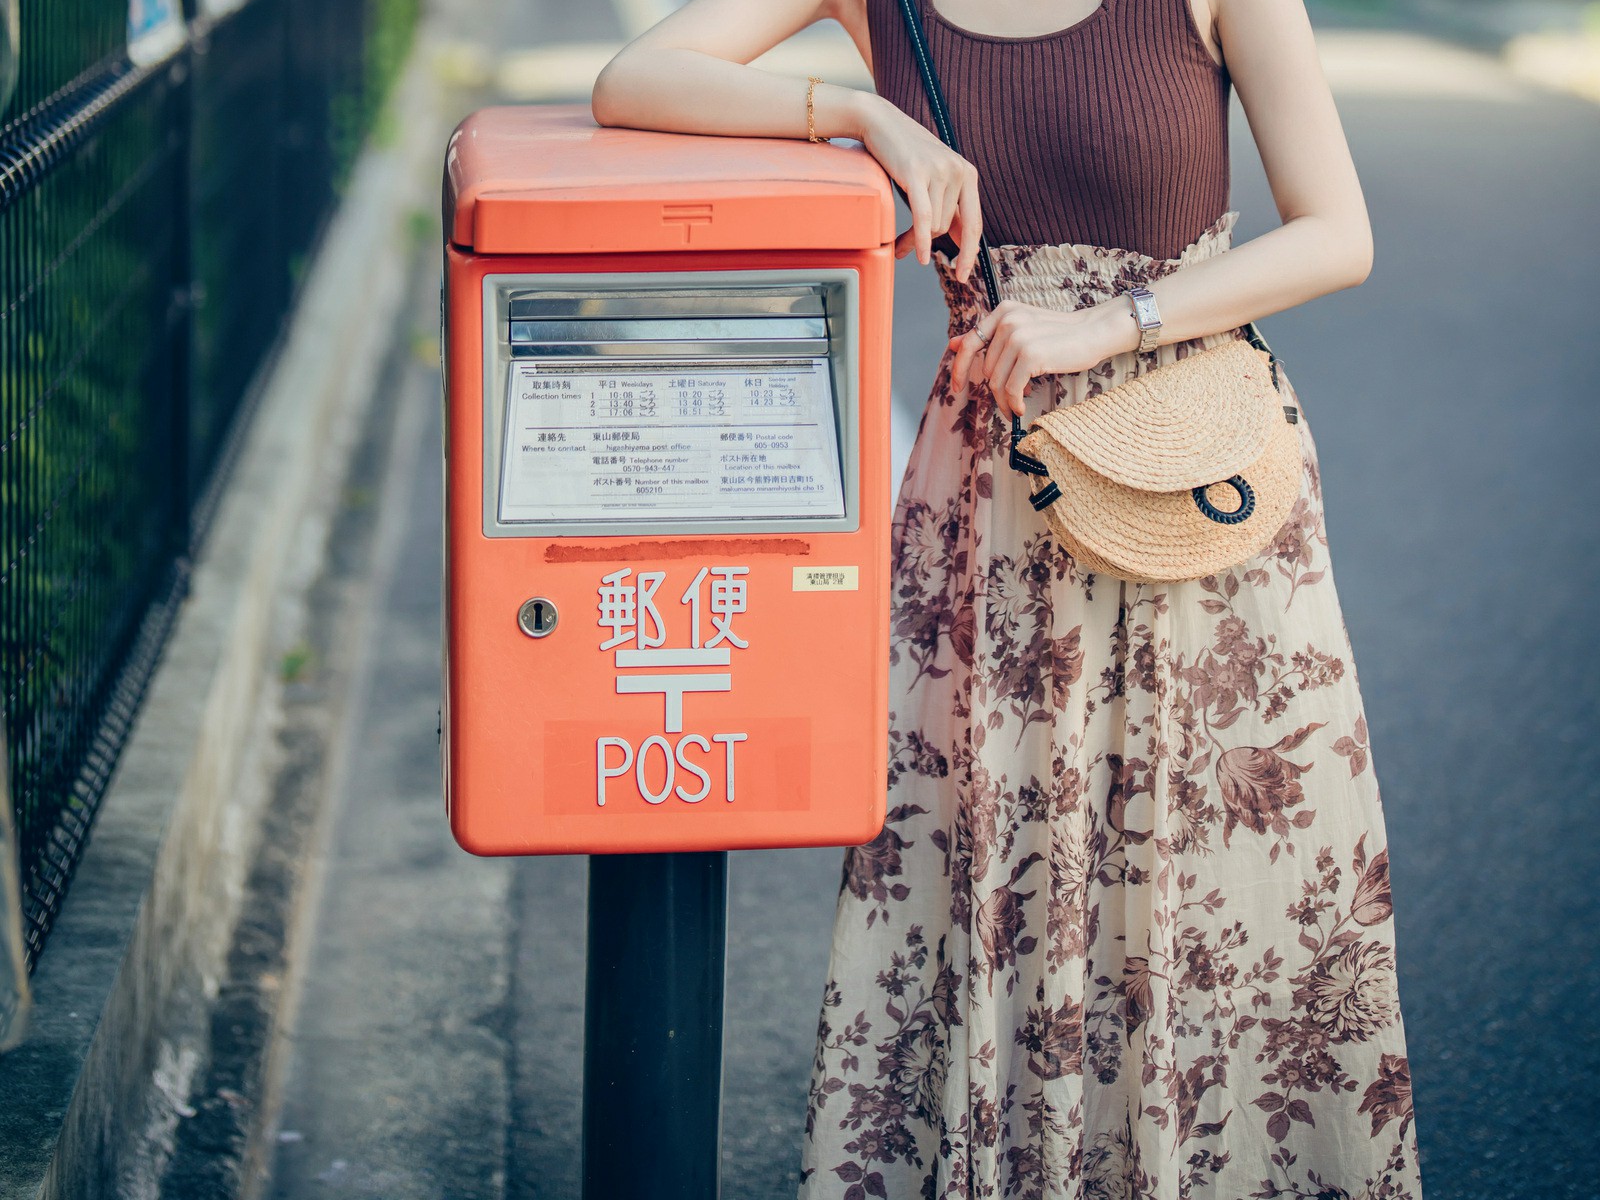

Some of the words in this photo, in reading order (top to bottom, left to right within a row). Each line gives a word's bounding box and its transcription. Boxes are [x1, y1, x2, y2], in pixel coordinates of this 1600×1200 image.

[598, 380, 616, 389] 平日
[668, 379, 696, 388] 土曜日
[744, 378, 762, 387] 休日
[537, 433, 567, 442] 連絡先
[593, 431, 640, 441] 東山郵便局
[720, 433, 753, 441] 郵便番号
[606, 443, 650, 451] higashiyama
[592, 456, 627, 465] 電話番号
[593, 477, 632, 486] ポスト番号
[636, 486, 663, 494] 605210
[598, 567, 750, 651] 郵便
[596, 733, 749, 807] POST
